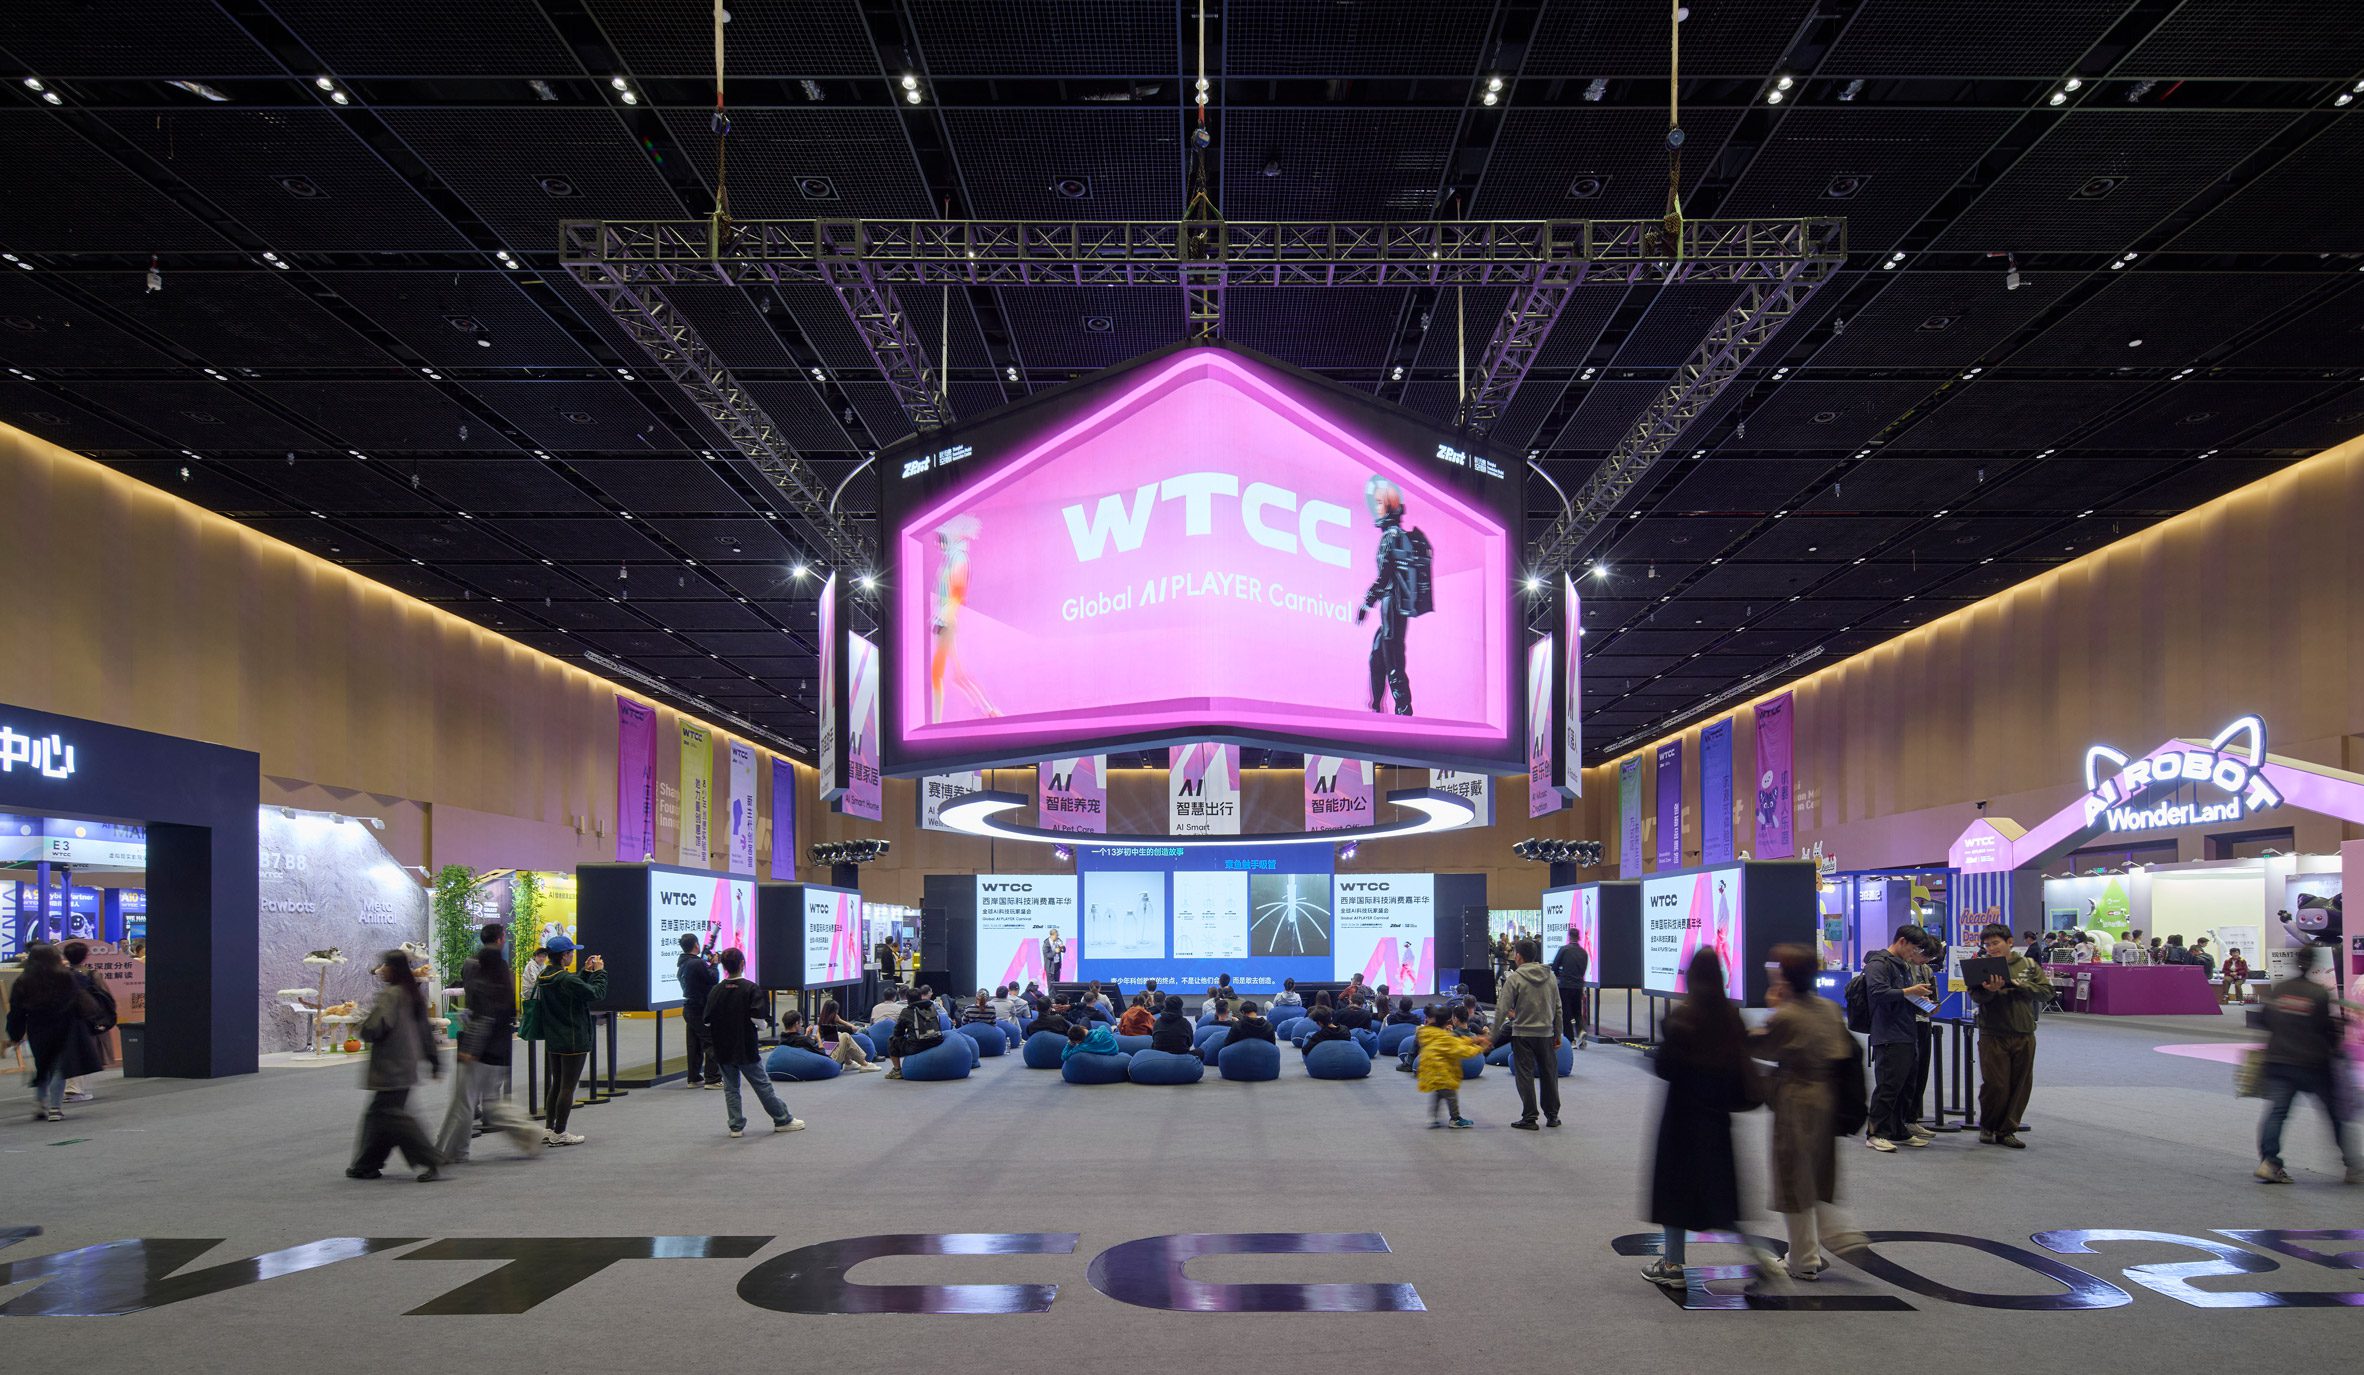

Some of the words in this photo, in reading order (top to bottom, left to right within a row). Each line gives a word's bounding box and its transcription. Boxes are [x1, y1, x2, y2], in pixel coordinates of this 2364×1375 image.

[1062, 472, 1351, 569] WTCC
[1062, 584, 1132, 622] Global
[1139, 576, 1168, 607] AI
[1172, 570, 1262, 603] PLAYER
[1268, 583, 1353, 623] Carnival
[682, 728, 703, 743] WTCC
[1659, 749, 1675, 761] WTCC
[1048, 772, 1073, 792] AI
[1178, 779, 1204, 797] AI
[1312, 774, 1337, 795] AI
[2084, 777, 2116, 829] AI
[2122, 752, 2277, 812] ROBOT
[1046, 796, 1101, 813] 智能养宠
[1176, 801, 1233, 816] 智慧出行
[1311, 795, 1367, 813] 智能办公
[2106, 796, 2242, 832] WonderLand
[1186, 823, 1211, 831] Smart
[1964, 836, 1996, 848] WTCC
[1091, 847, 1184, 857] 一个13岁初中生的创造故事
[982, 883, 1033, 892] WTCC
[1341, 882, 1390, 891] WTCC
[260, 898, 316, 913] Pawbots
[363, 899, 393, 912] Meta
[660, 891, 697, 907] WTCC
[1650, 894, 1678, 908] WTCC
[809, 903, 829, 914] WTCC
[1546, 905, 1563, 915] WTCC
[1960, 907, 2000, 925] Reachy
[359, 911, 397, 925] Animal
